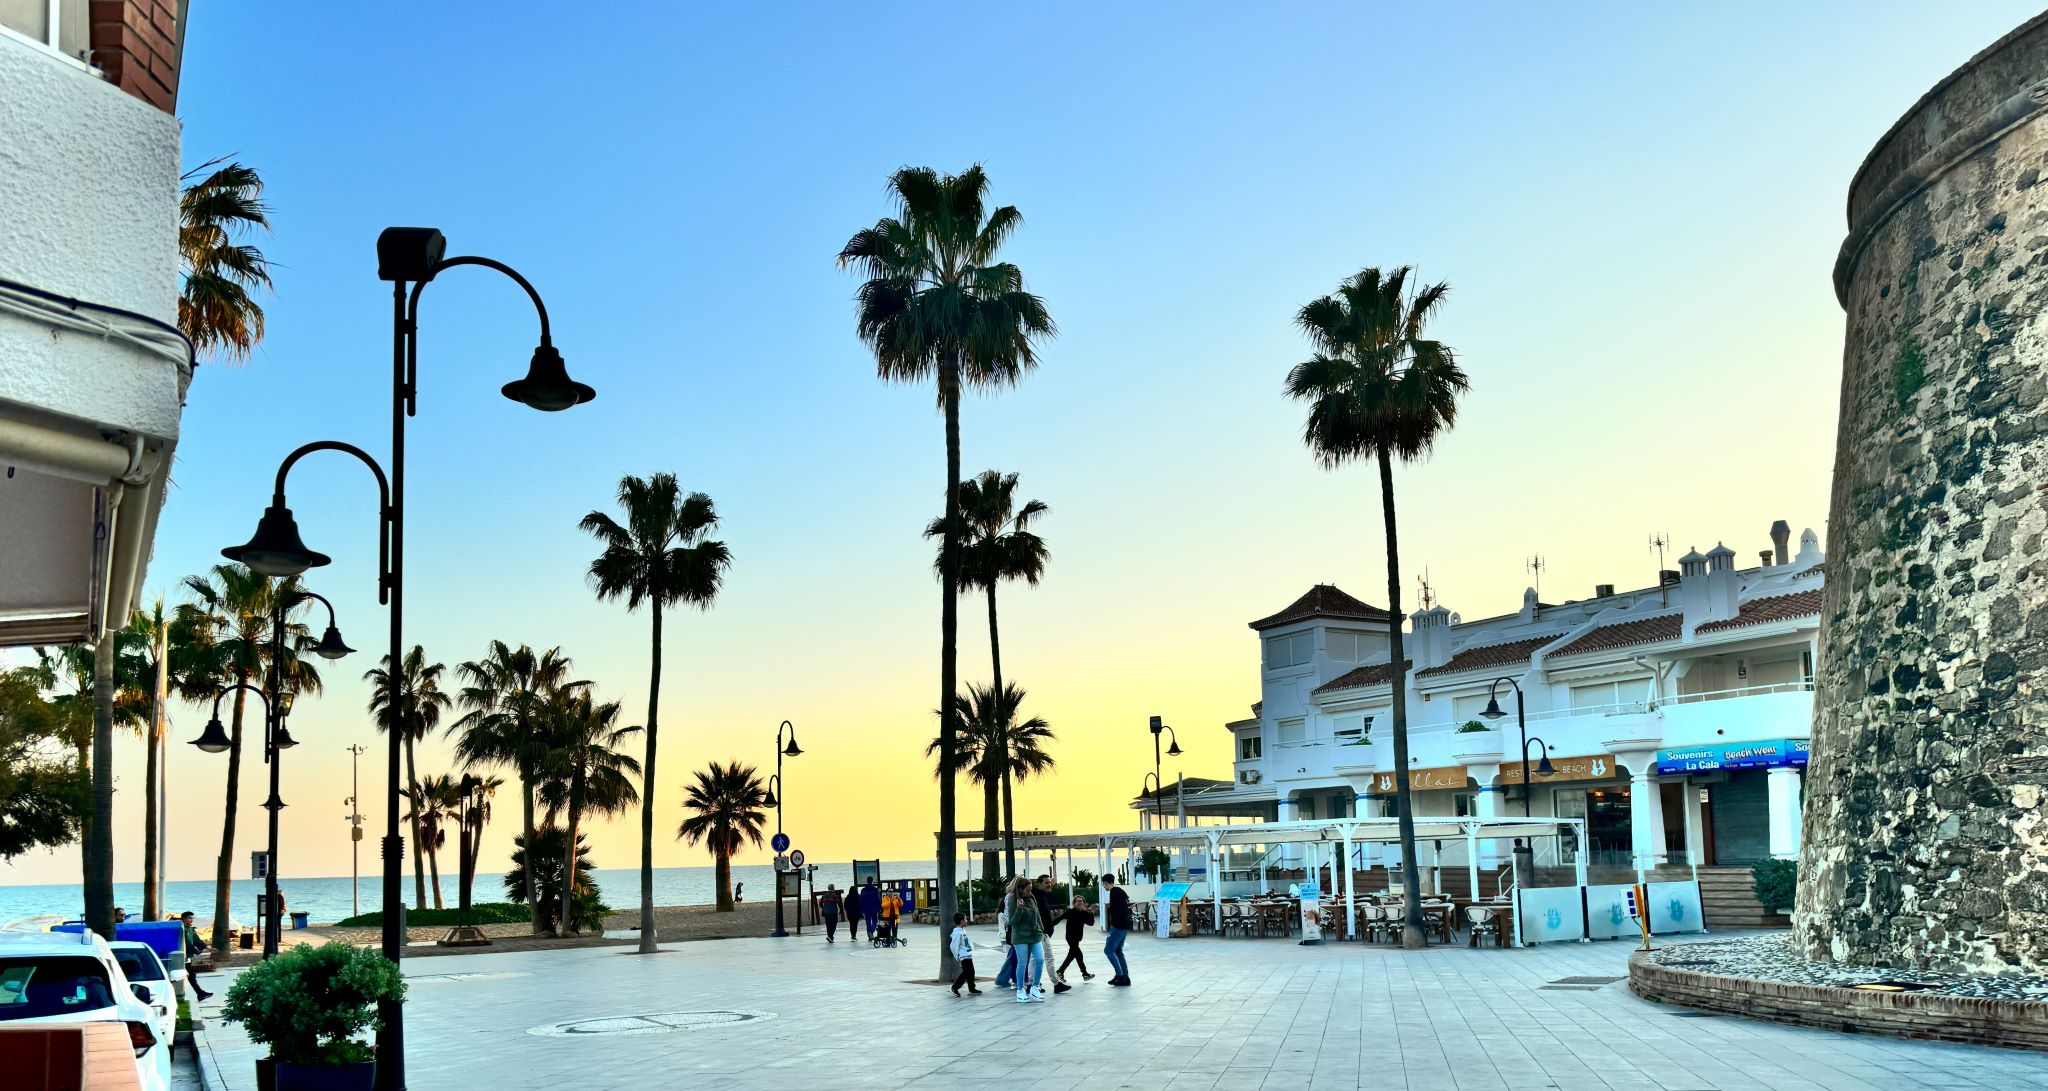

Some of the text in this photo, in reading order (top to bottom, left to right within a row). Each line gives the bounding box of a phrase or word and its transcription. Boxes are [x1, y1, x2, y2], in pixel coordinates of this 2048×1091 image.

[1667, 749, 1714, 760] Souvenirs
[1562, 765, 1586, 774] BEACH
[1686, 762, 1697, 770] La
[1699, 760, 1720, 769] Cala
